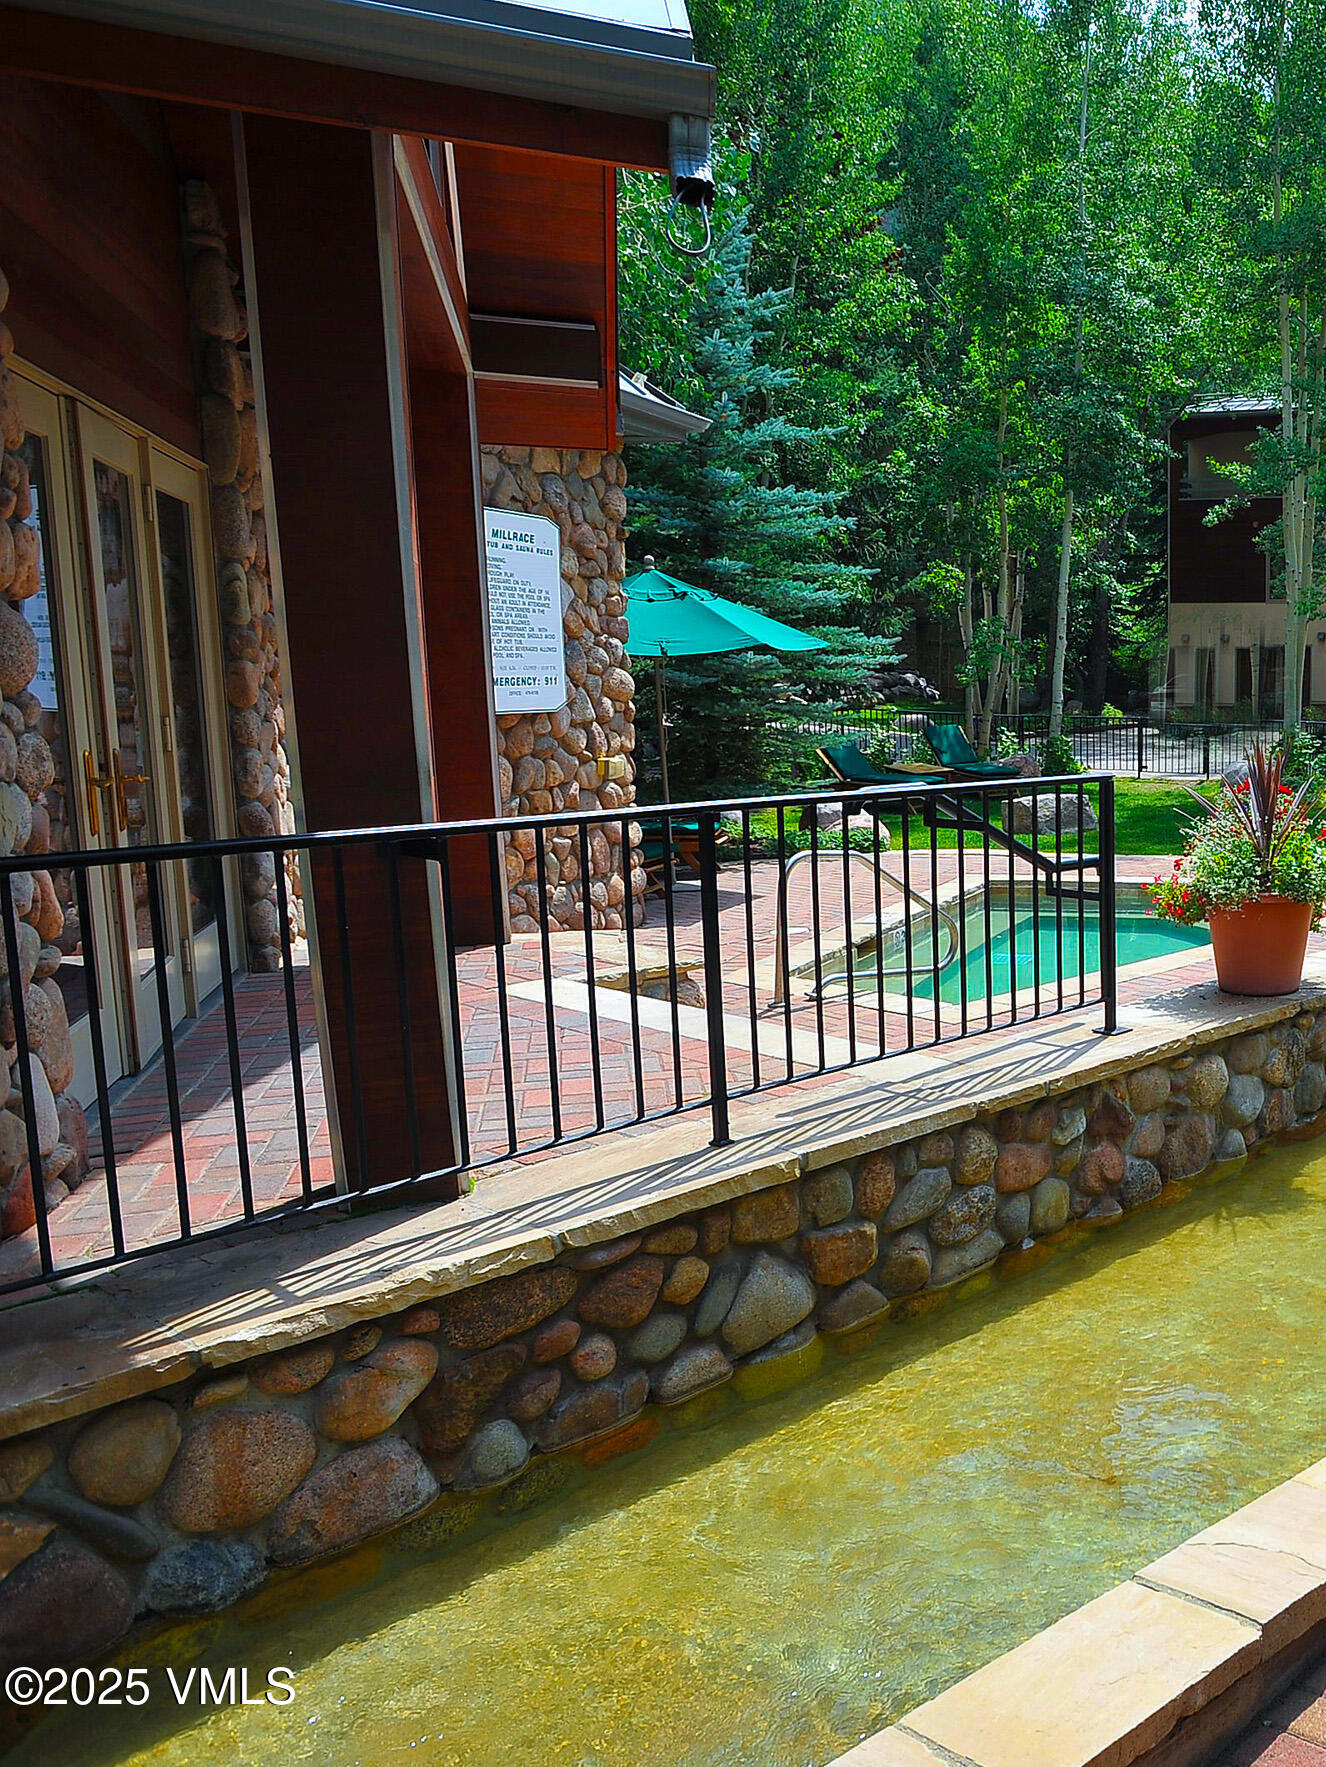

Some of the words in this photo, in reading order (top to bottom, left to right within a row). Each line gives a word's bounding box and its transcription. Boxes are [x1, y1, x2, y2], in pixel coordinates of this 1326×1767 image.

[491, 528, 535, 544] MILLRACE
[487, 540, 498, 549] TUB
[501, 542, 513, 551] AND
[516, 544, 534, 553] SAUNA
[536, 547, 553, 556] RULES
[494, 676, 541, 687] MERGENCY:
[544, 676, 557, 686] 911
